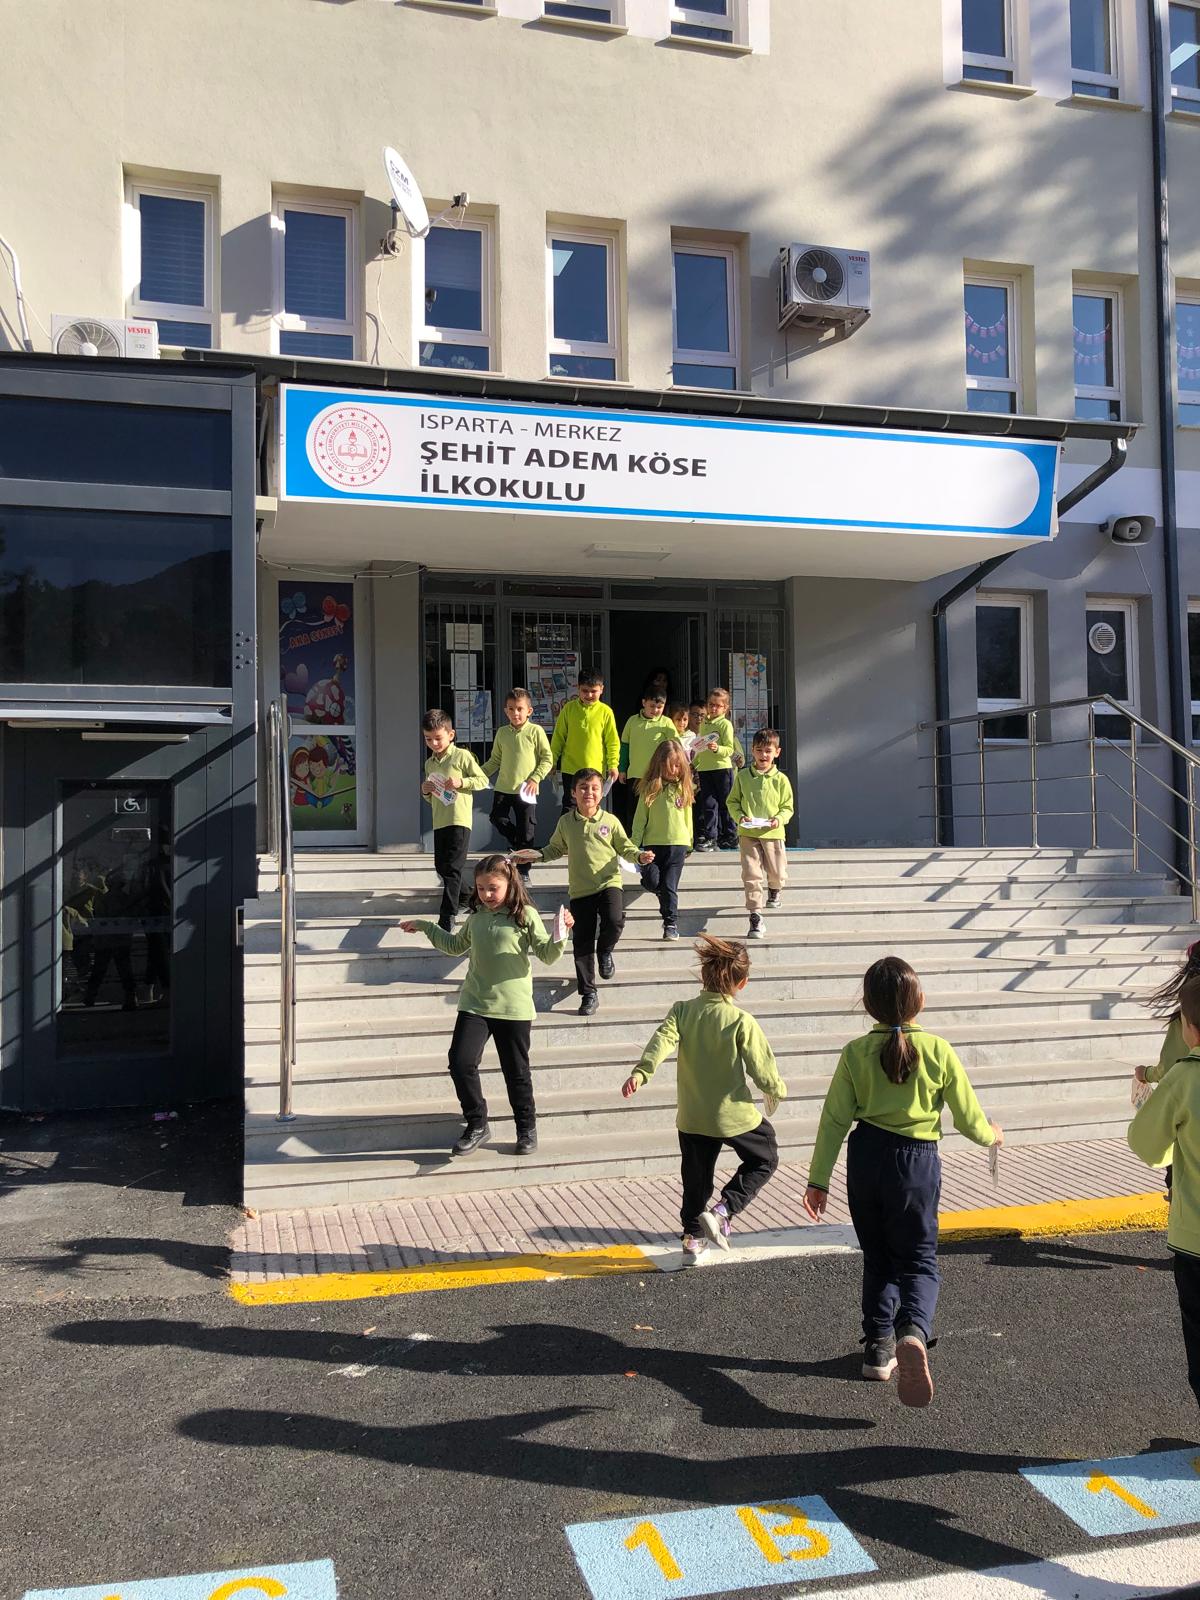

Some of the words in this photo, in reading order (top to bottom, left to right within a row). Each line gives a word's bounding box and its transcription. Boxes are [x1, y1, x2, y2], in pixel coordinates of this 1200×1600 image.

[848, 255, 868, 263] VESTEL
[127, 327, 152, 335] VESTEL
[420, 413, 514, 435] ISPARTA
[534, 422, 622, 442] MERKEZ
[420, 440, 516, 466] ŞEHİT
[523, 449, 618, 472] ADEM
[628, 452, 707, 477] KÖSE
[420, 469, 586, 502] İLKOKULU
[1086, 1468, 1158, 1519] 1
[624, 1521, 684, 1580] 1
[736, 1503, 830, 1564] B
